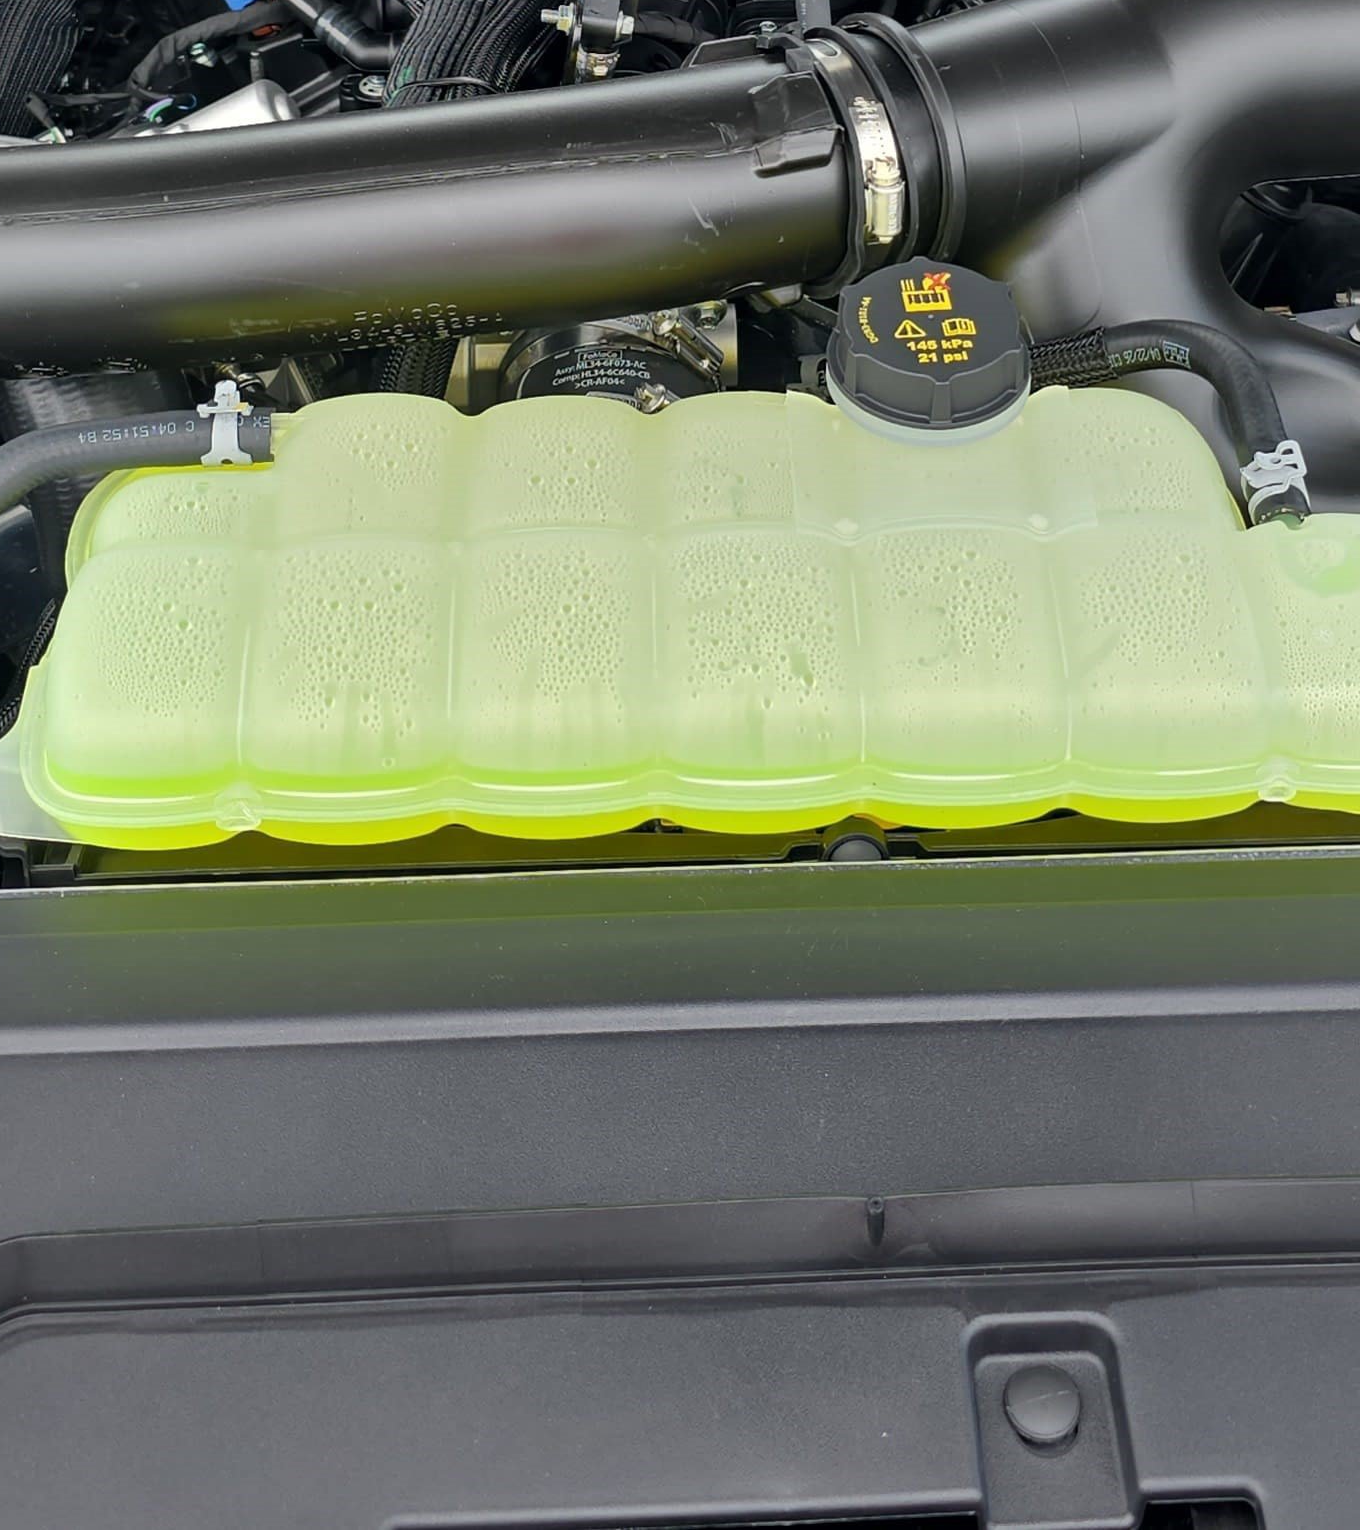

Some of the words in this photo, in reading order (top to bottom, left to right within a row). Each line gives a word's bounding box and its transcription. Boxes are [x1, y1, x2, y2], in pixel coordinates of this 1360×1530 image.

[906, 340, 938, 351] 145
[941, 339, 973, 349] kPa
[582, 350, 618, 360] FoMoCo
[917, 352, 938, 363] 21
[943, 351, 968, 364] psi
